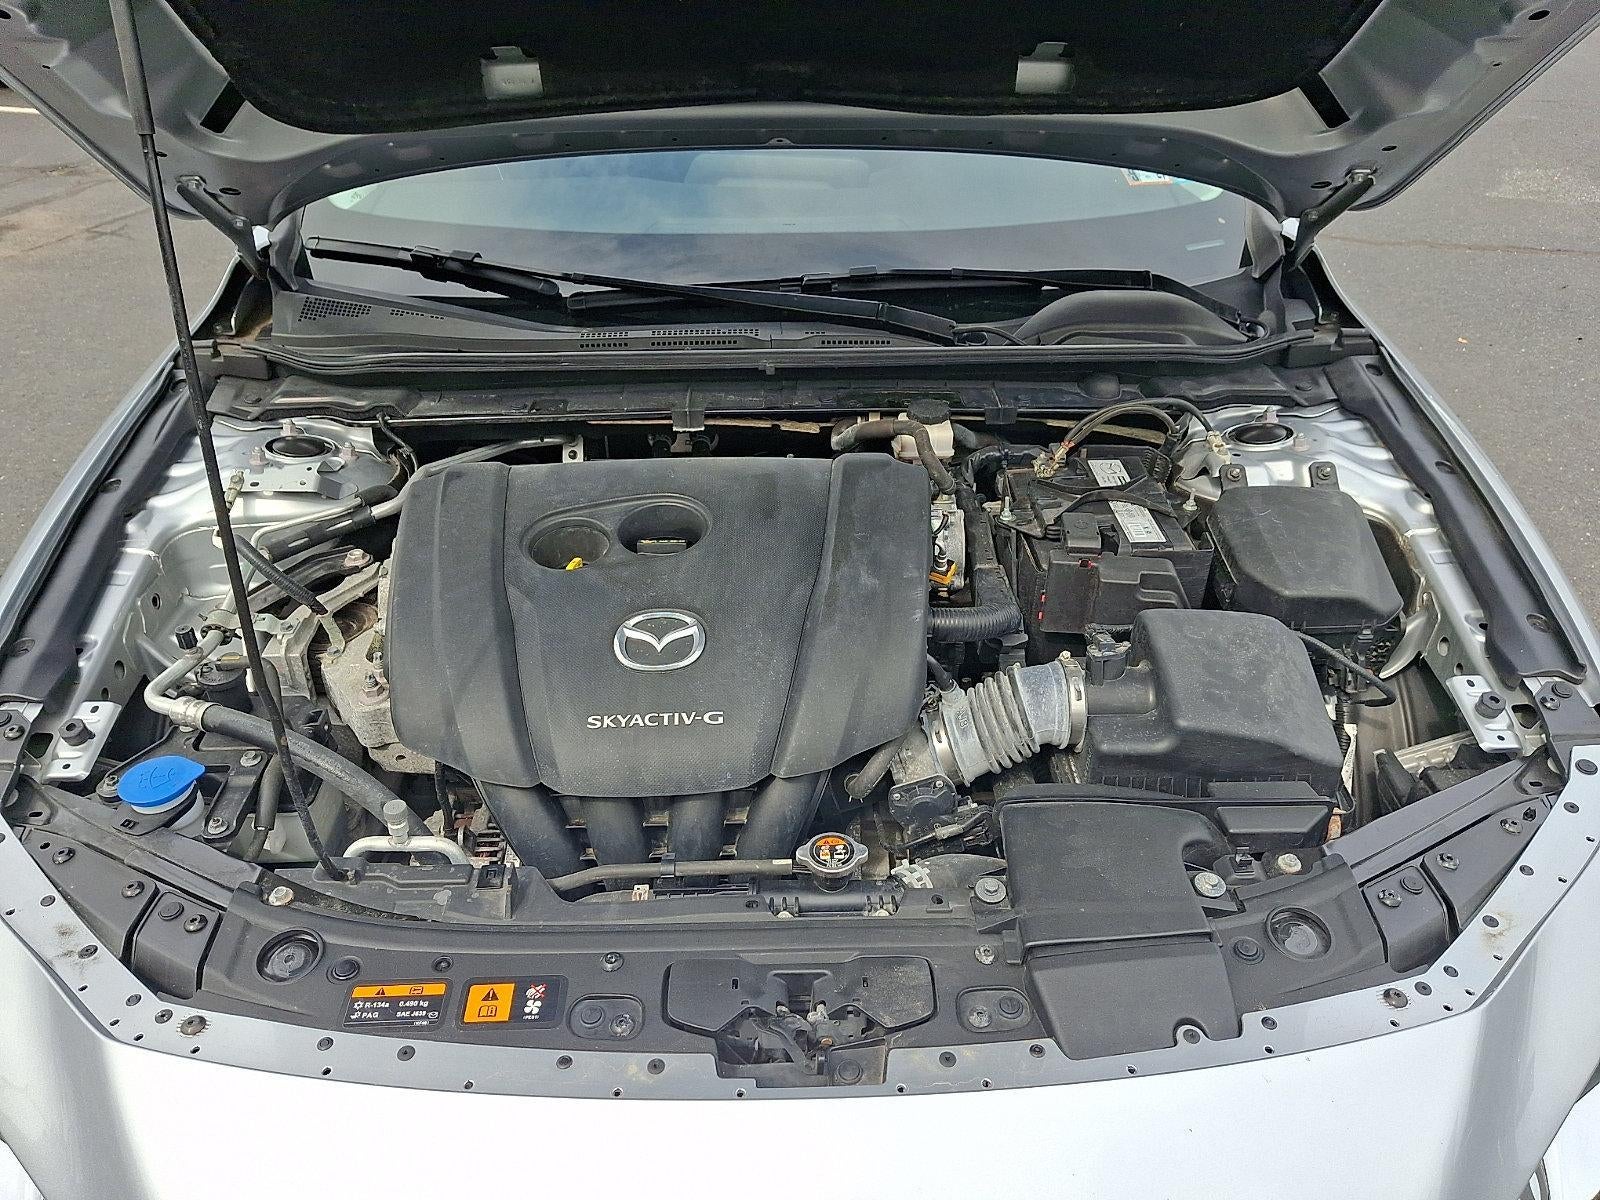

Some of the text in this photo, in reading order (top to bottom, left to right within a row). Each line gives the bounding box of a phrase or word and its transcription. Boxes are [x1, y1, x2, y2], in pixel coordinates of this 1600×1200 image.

[586, 711, 724, 729] SKYACTIV-G
[364, 1001, 390, 1009] R-134a
[419, 1000, 429, 1008] kg
